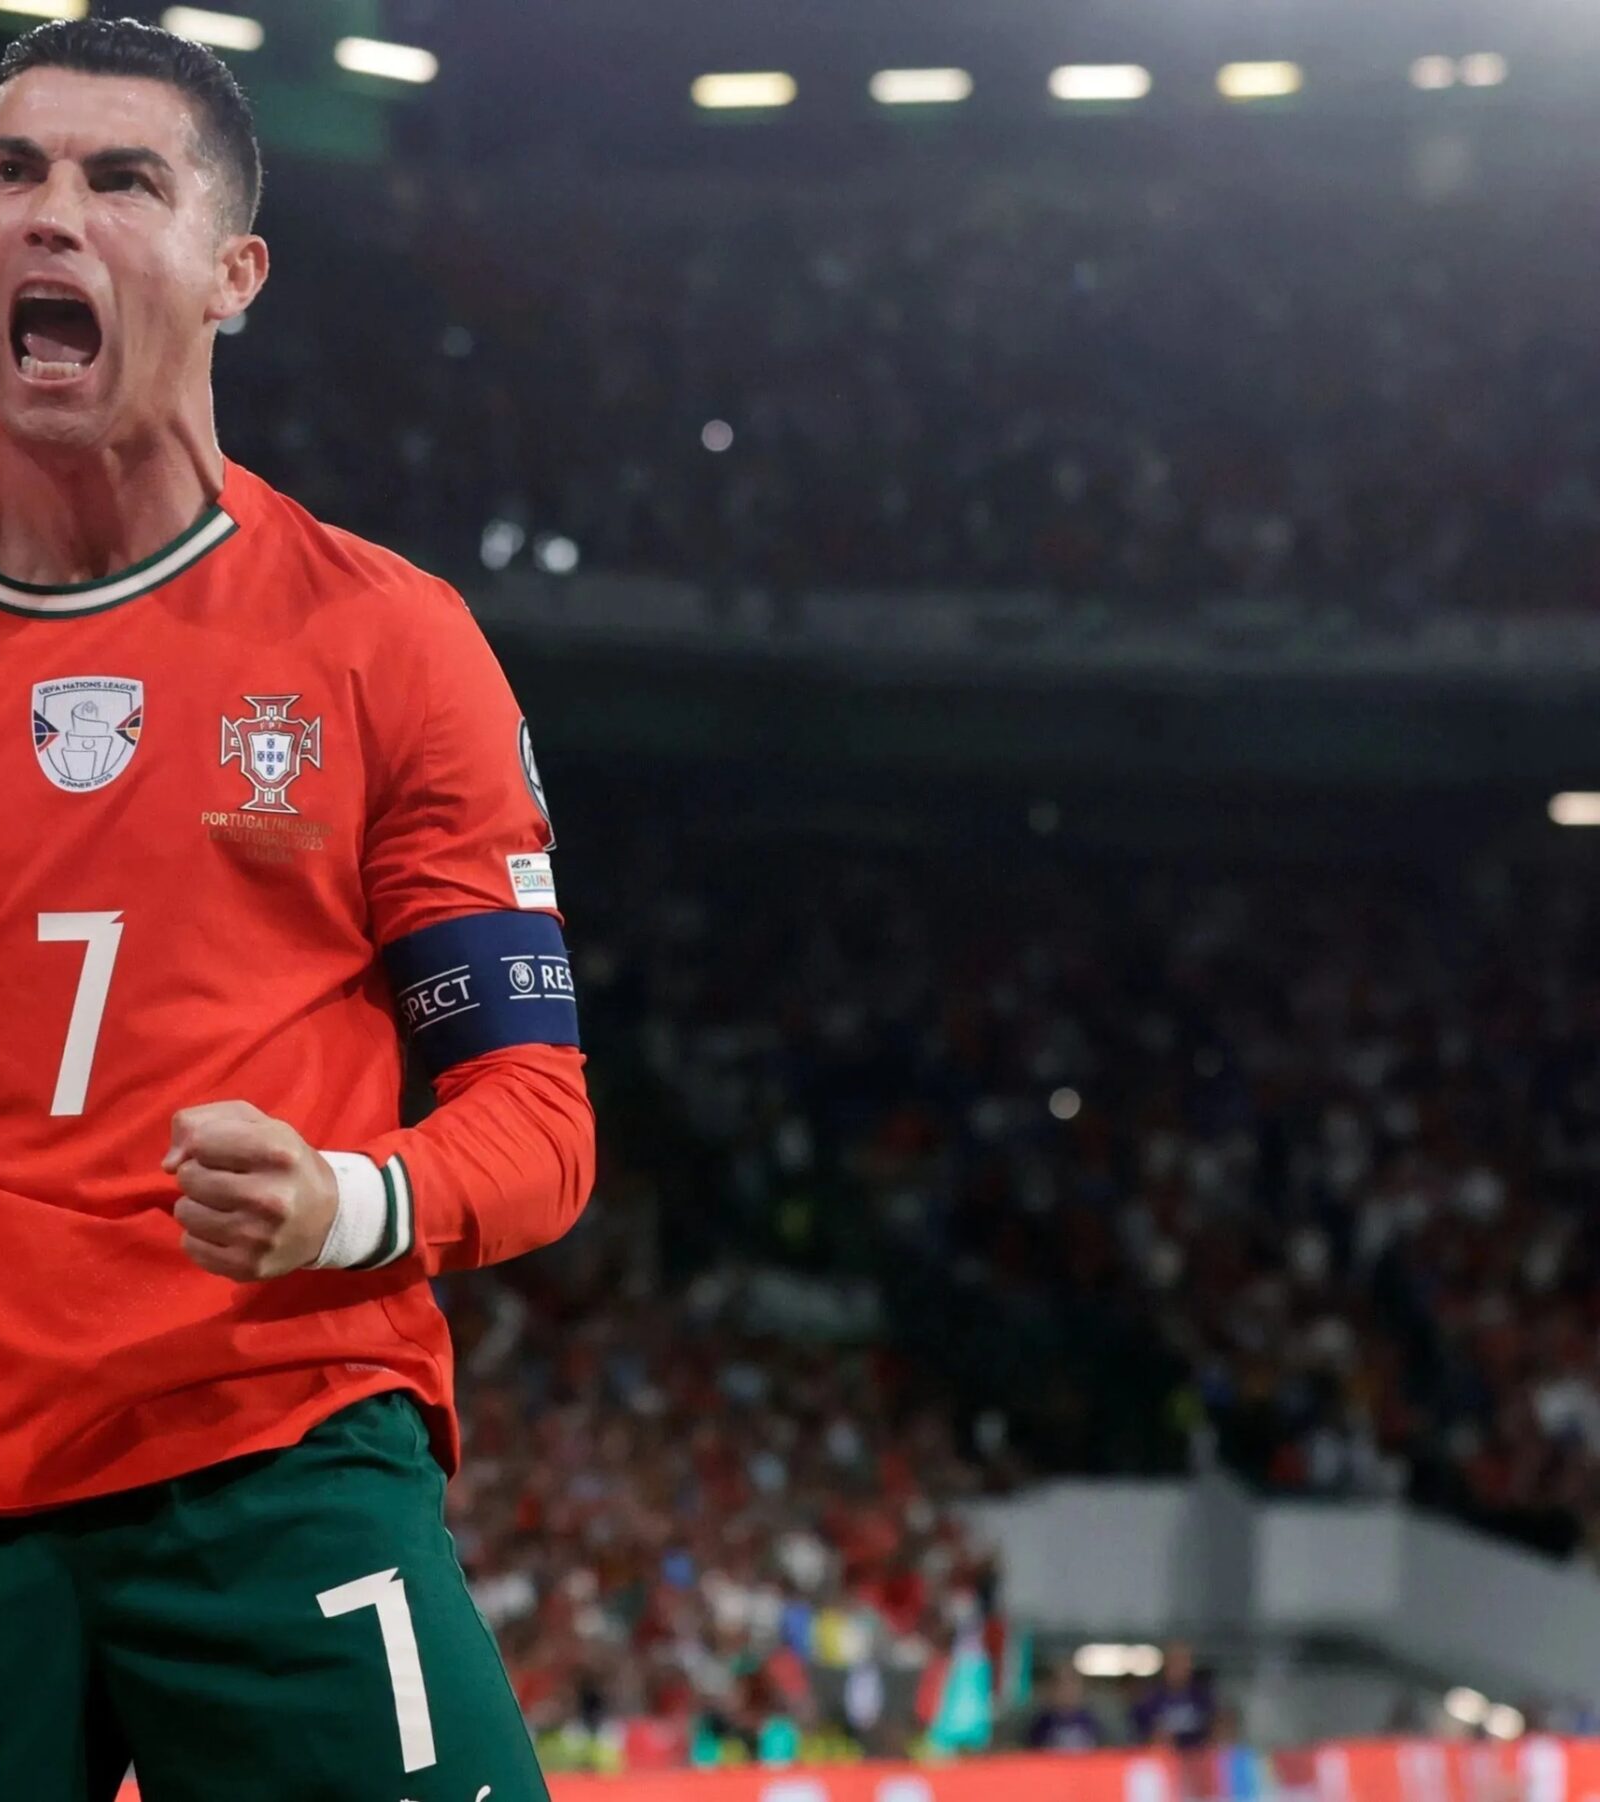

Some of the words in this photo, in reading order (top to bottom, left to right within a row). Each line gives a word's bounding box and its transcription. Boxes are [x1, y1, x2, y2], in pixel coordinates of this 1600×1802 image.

[38, 685, 60, 695] UEFA
[63, 681, 102, 690] NATIONS
[104, 682, 137, 692] LEAGUE
[59, 778, 92, 788] WINNER
[293, 836, 324, 851] 2025
[37, 910, 125, 1117] 7
[315, 1567, 437, 1773] 7
